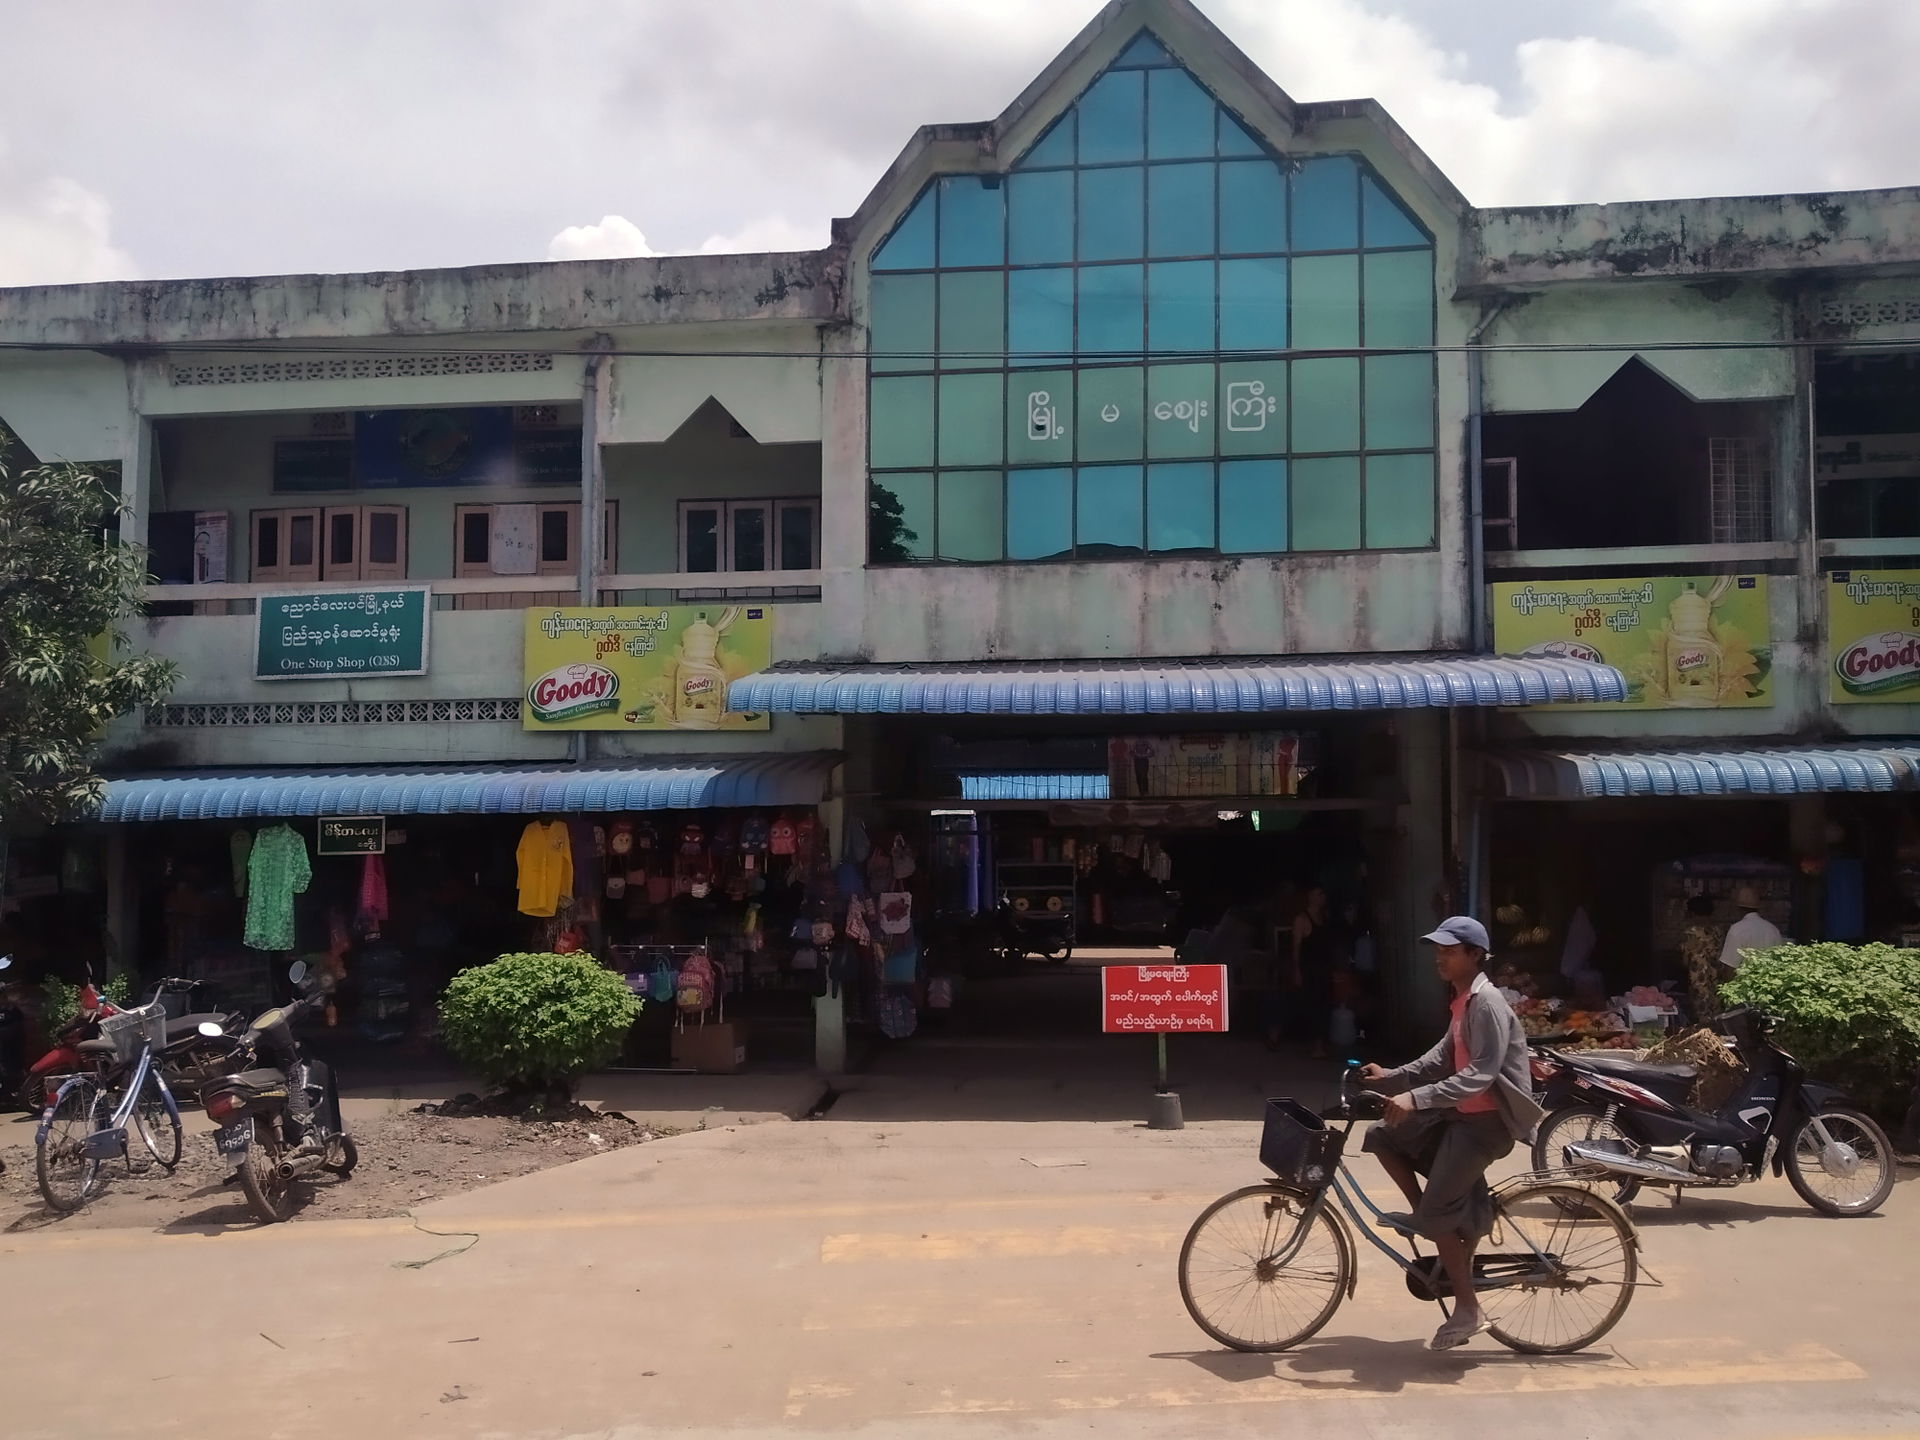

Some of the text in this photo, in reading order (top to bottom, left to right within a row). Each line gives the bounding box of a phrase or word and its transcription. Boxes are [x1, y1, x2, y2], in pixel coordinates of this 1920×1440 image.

[1101, 403, 1120, 423] မ
[281, 658, 304, 670] One
[308, 657, 333, 671] Stop
[337, 656, 365, 669] Shop
[1678, 653, 1704, 667] Goody
[536, 670, 612, 706] Goody
[686, 678, 709, 690] Goody
[1175, 989, 1218, 1006] ပေါက်တွင်
